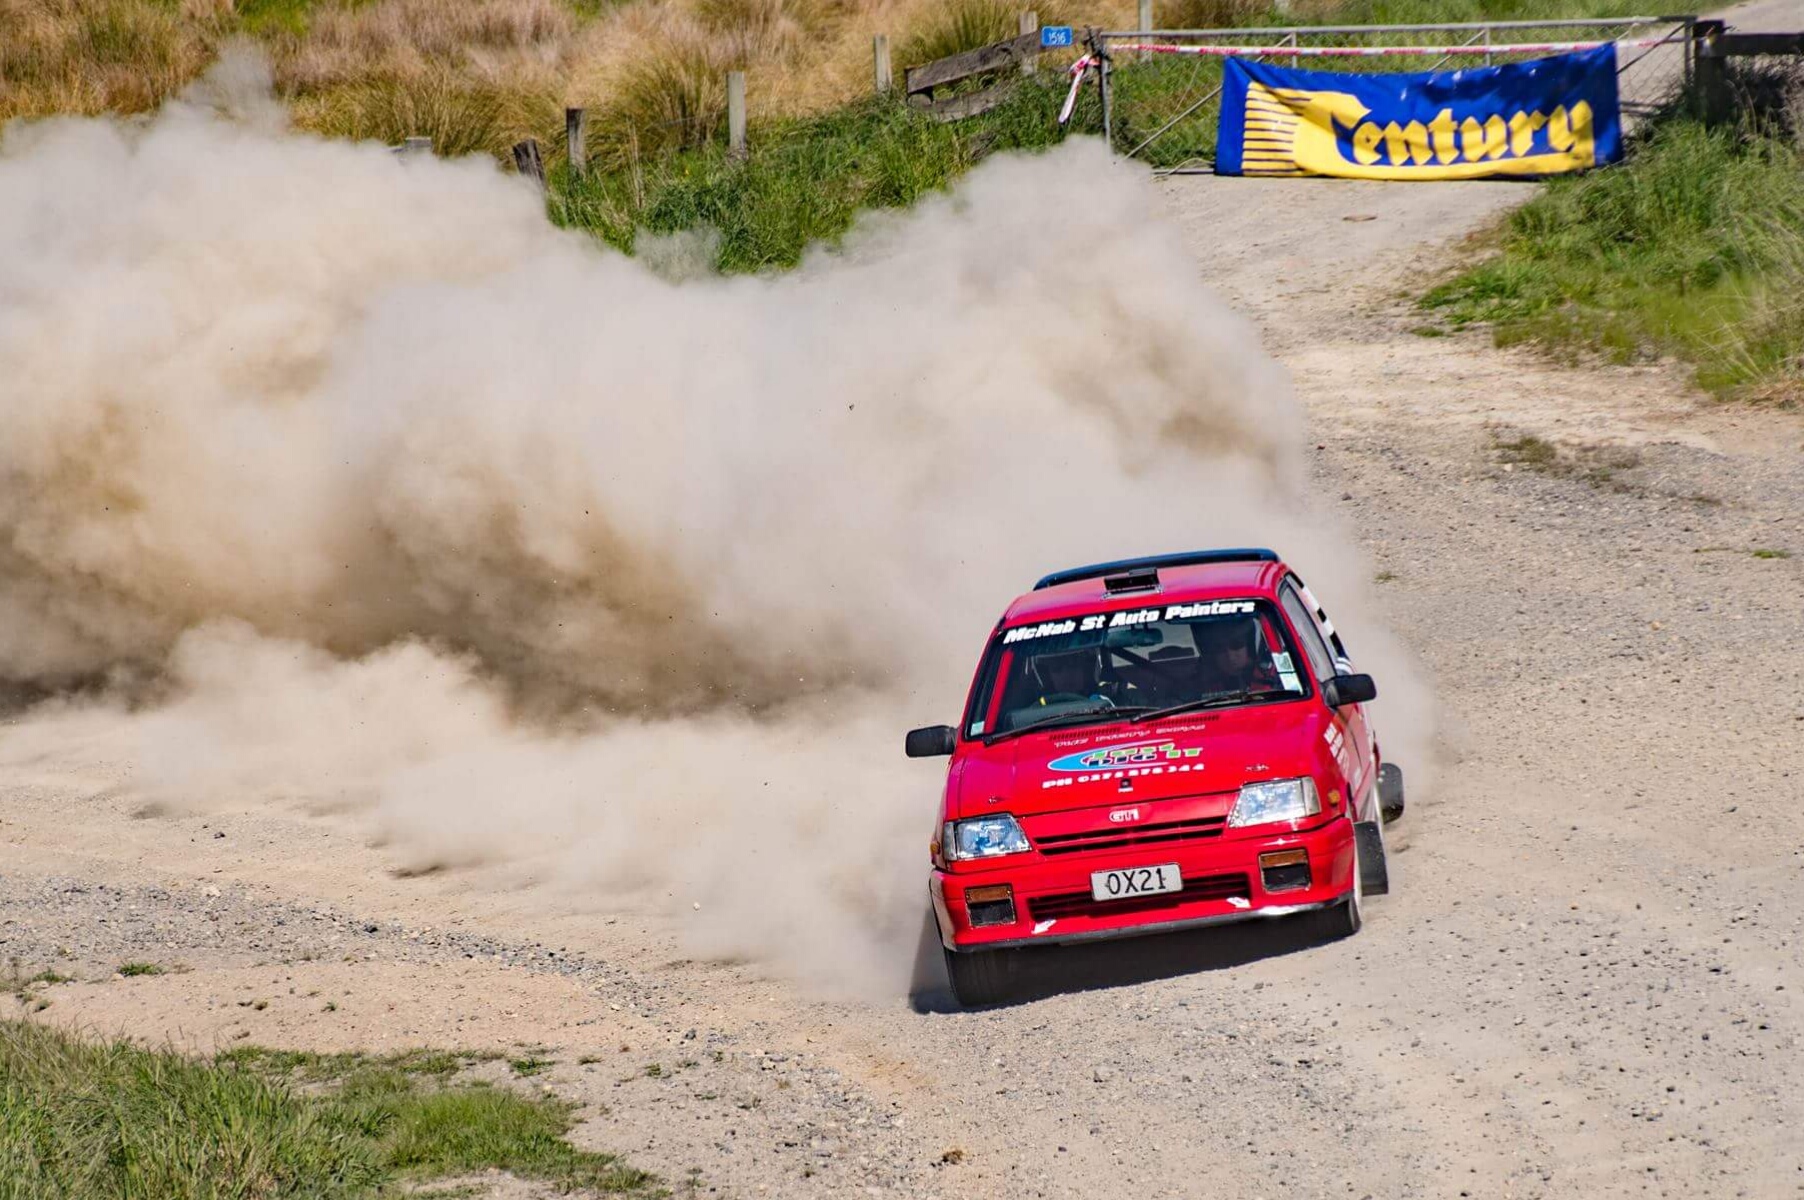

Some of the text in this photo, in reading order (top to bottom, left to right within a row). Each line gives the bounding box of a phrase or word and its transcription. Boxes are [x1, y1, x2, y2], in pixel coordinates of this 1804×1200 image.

[1280, 86, 1594, 180] Century
[1003, 601, 1256, 645] McNab St Auto Painters
[1107, 867, 1166, 895] OX21
